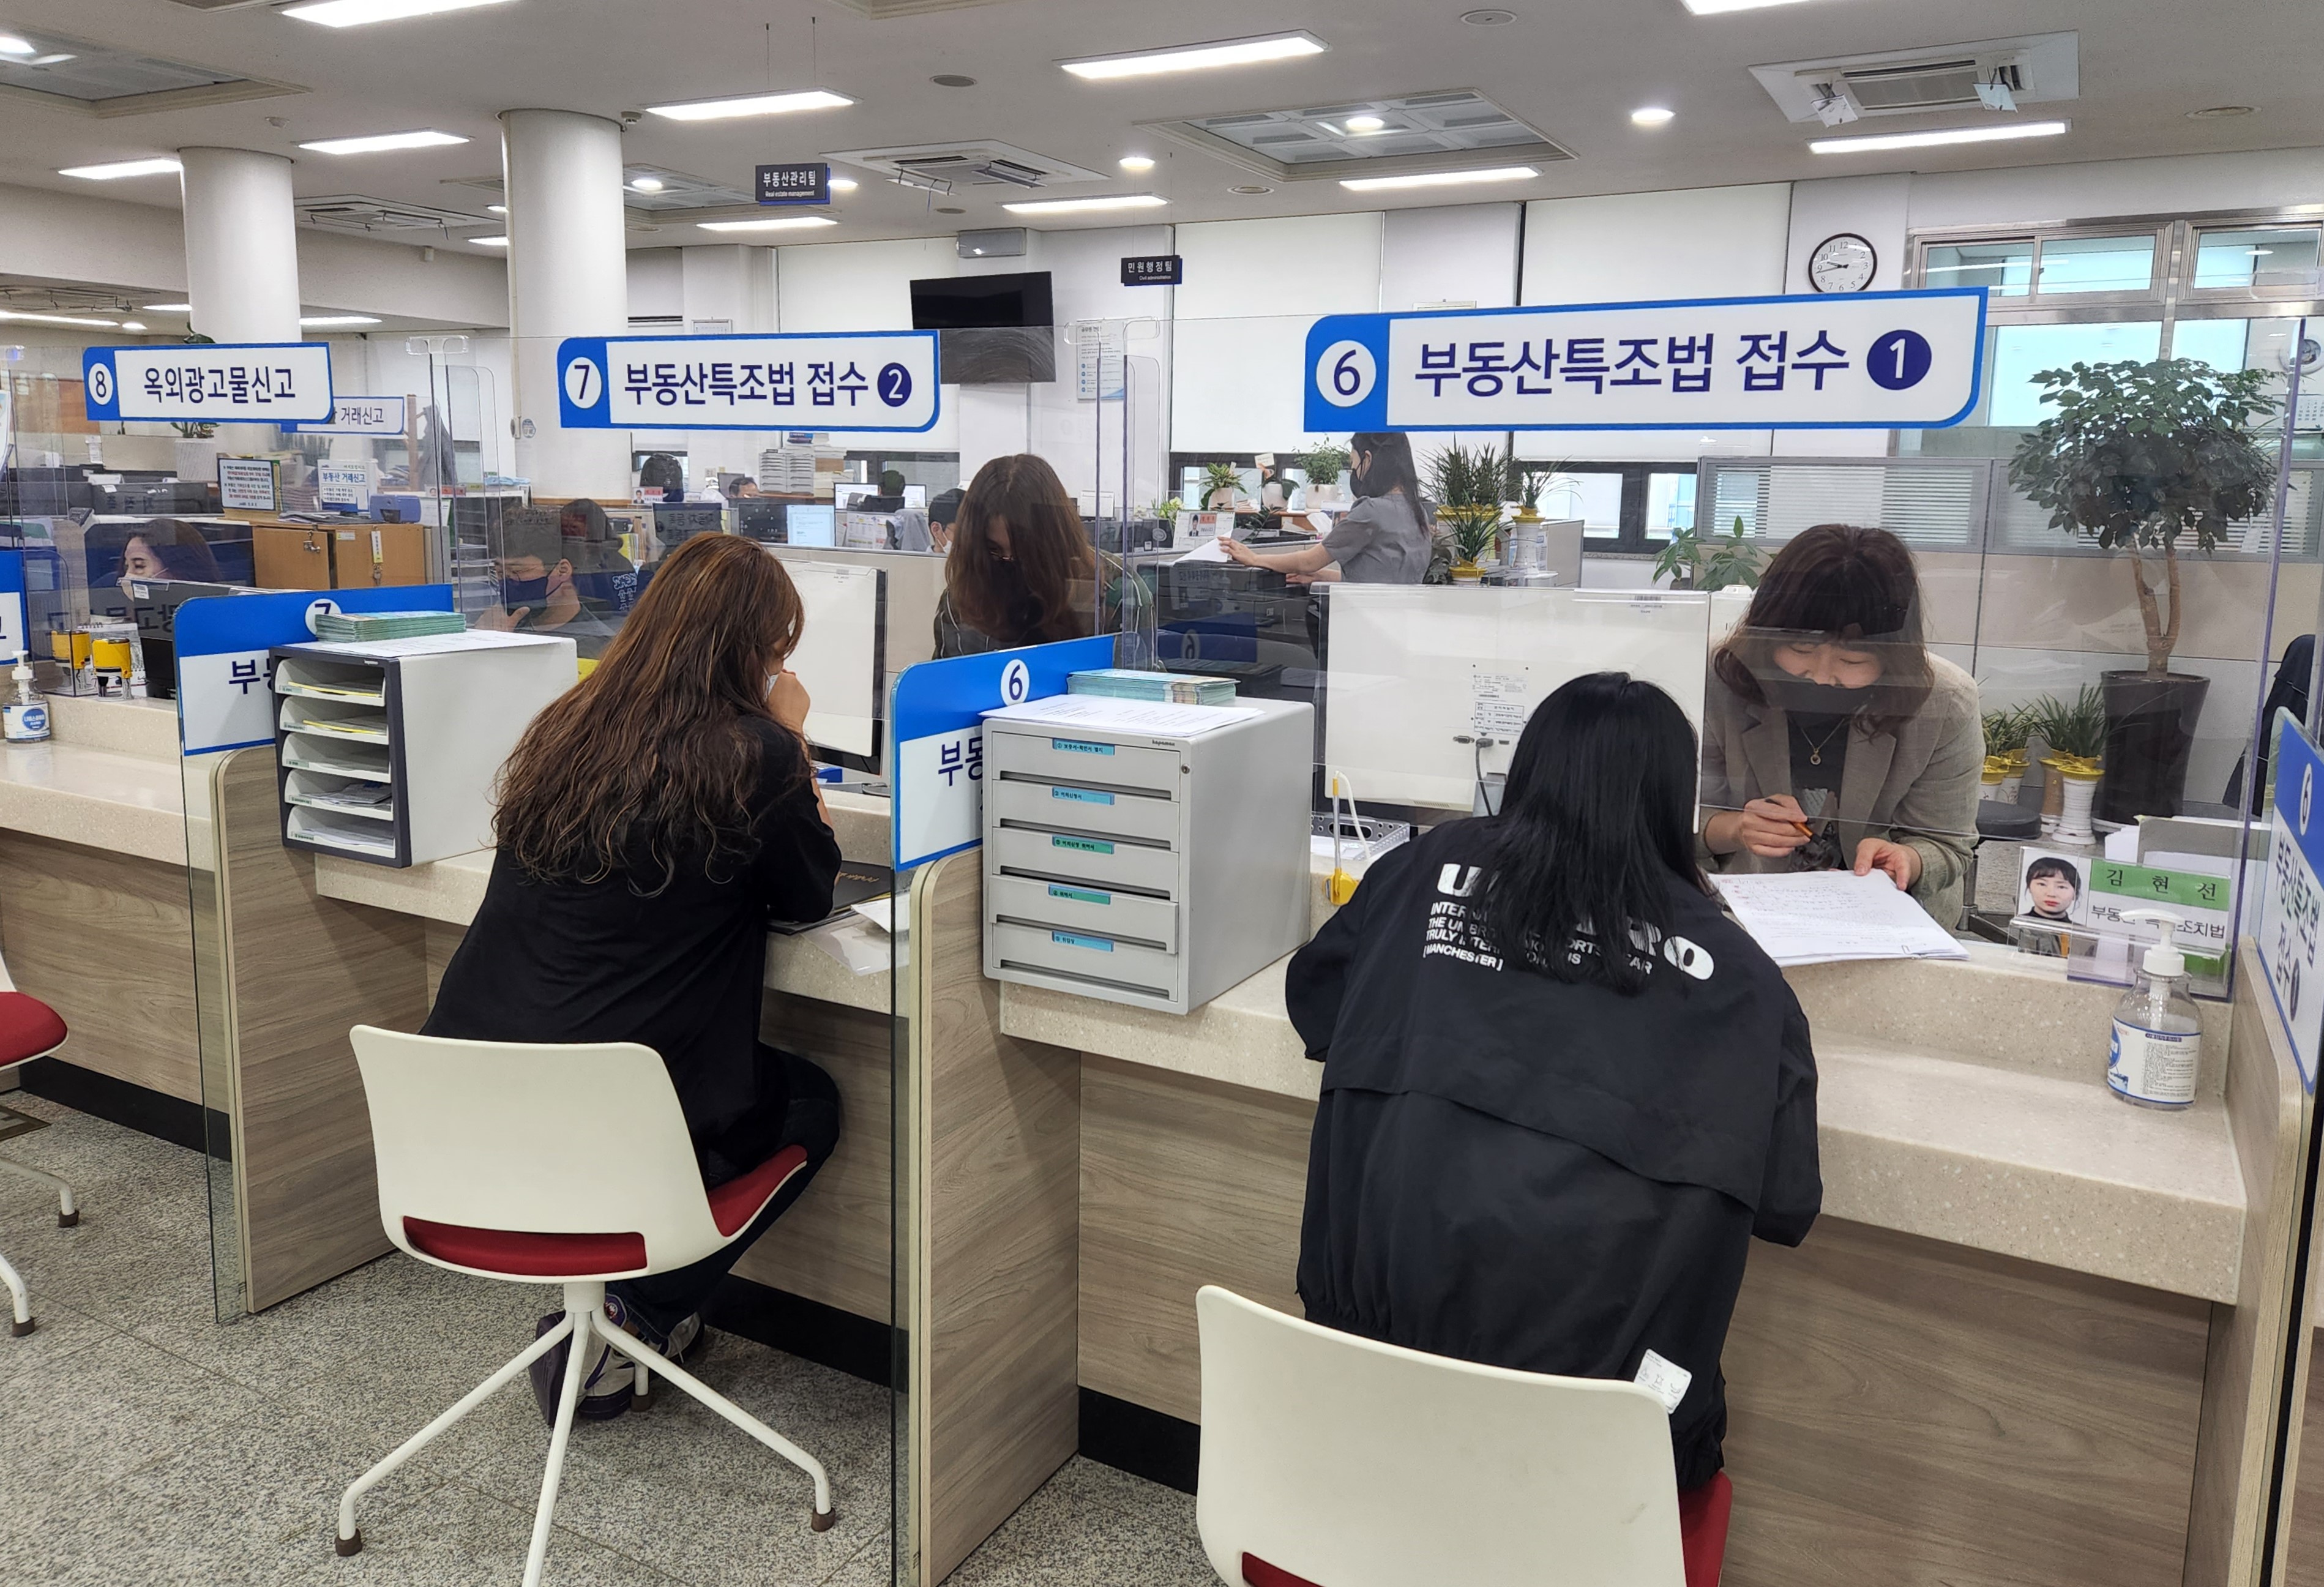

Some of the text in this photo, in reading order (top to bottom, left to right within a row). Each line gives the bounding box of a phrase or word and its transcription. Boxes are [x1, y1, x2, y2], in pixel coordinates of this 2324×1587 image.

[763, 170, 816, 187] 부동산관리팀
[1839, 241, 1849, 250] 12
[1128, 261, 1172, 273] 민원행정팀
[1333, 348, 1361, 396] 6
[1414, 332, 1714, 398] 부동산특조법
[1736, 329, 1851, 392] 접수
[95, 367, 296, 403] 8 옥외광고물신고
[574, 364, 591, 400] 7
[624, 362, 794, 406] 부동산특조법
[806, 361, 869, 406] 접수
[341, 406, 384, 425] 거래신고
[323, 472, 365, 483] 부동산 거래신고
[1009, 664, 1023, 701] 6
[2302, 772, 2311, 826] 6
[2276, 831, 2321, 970] 부동산특조법
[1429, 917, 1446, 928] THE
[2091, 905, 2135, 925] 부동
[1426, 928, 1459, 942] TRULY
[2275, 920, 2292, 999] 접수
